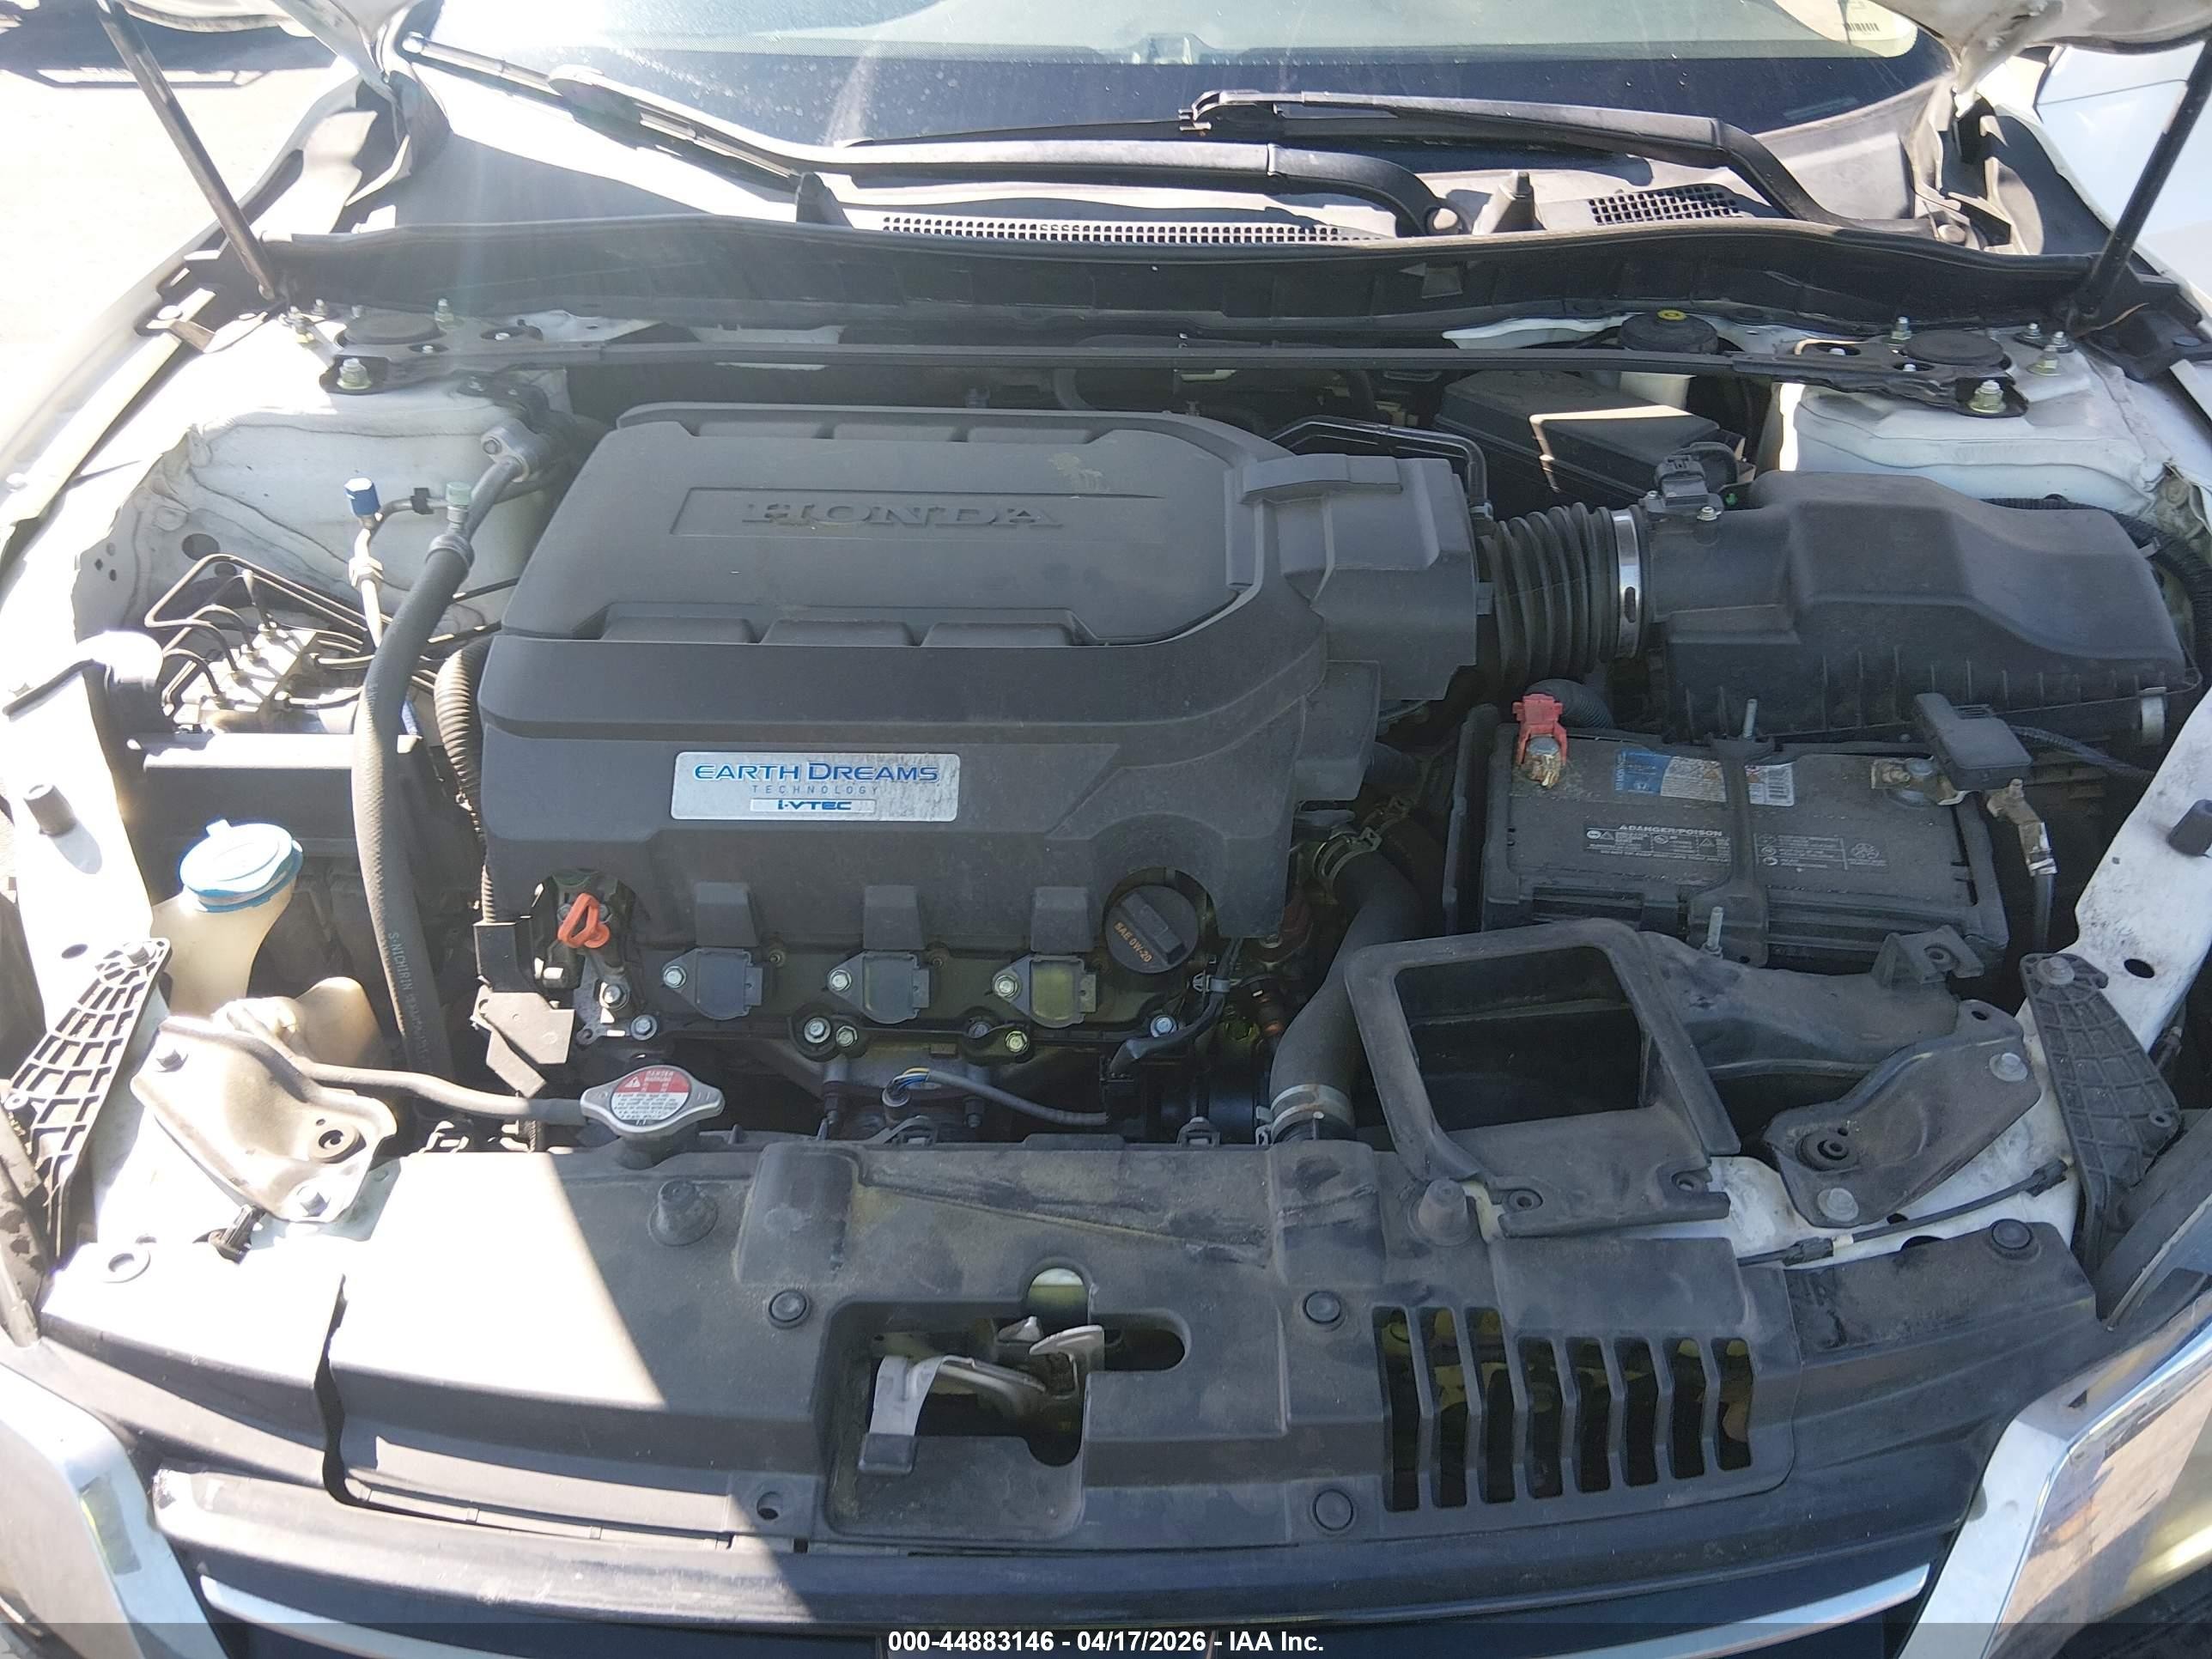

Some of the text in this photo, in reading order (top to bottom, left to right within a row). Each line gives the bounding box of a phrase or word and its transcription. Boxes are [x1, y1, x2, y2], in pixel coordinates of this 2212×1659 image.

[741, 502, 1064, 529] HONDA
[694, 762, 939, 782] EARTH DREAMS
[750, 785, 880, 795] TECHNOLOGY
[777, 799, 853, 811] i-VTEC
[1114, 922, 1152, 963] SAE 0W-20
